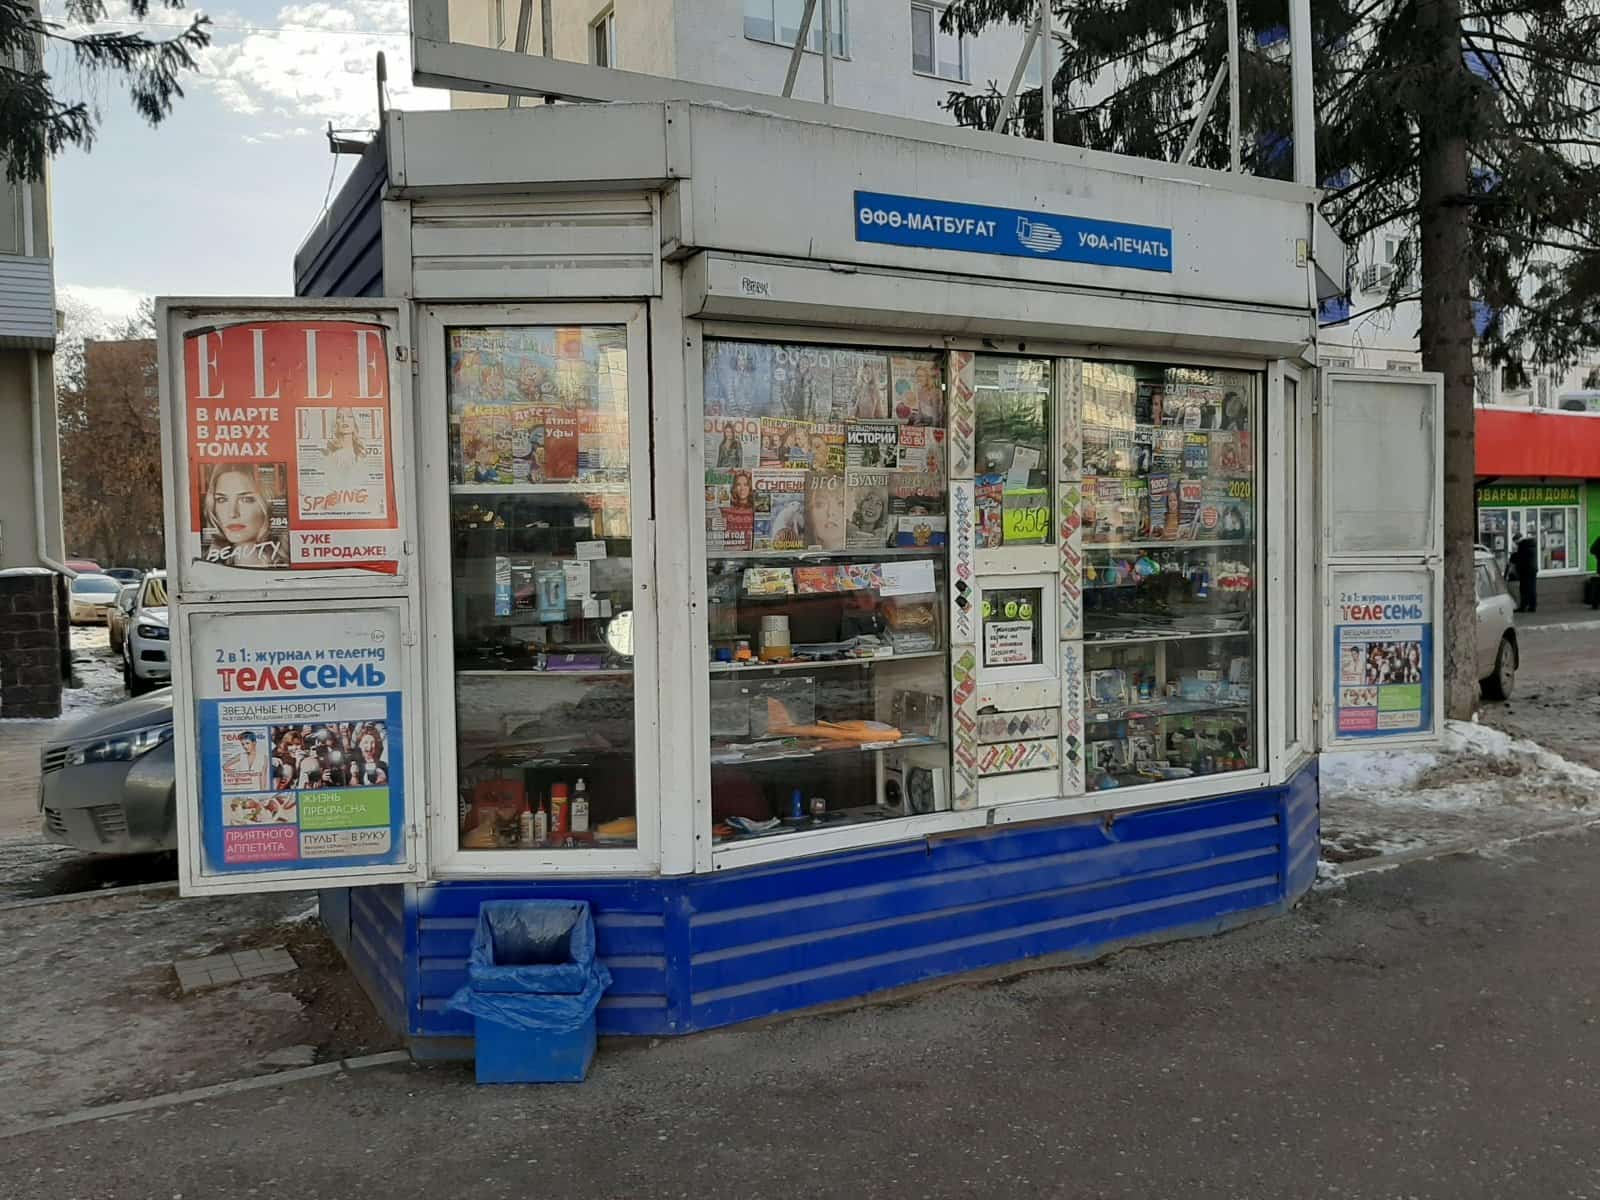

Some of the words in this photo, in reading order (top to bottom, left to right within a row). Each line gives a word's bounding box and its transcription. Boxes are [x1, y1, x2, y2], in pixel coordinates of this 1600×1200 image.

[1078, 231, 1169, 257] УФА-ПЕЧАТЬ
[195, 328, 385, 399] ELLE
[196, 407, 208, 422] В
[215, 407, 279, 422] МАРТЕ
[196, 424, 208, 440] В
[215, 424, 270, 440] ДВУХ
[545, 427, 574, 439] Уфы
[847, 432, 896, 444] ИСТОРИИ
[196, 442, 269, 457] ТОМАХ
[1229, 480, 1250, 498] 2020
[1477, 489, 1518, 501] ОВАРЫ
[1520, 489, 1544, 502] ДЛЯ
[1546, 488, 1576, 501] ДОМА
[300, 534, 331, 545] УЖЕ
[206, 541, 281, 562] BEAUTY
[301, 547, 310, 558] В
[313, 546, 386, 558] ПРОДАЖЕ!
[1341, 592, 1346, 601] 2
[216, 649, 225, 663] 2
[229, 652, 236, 663] в
[240, 648, 251, 662] 1:
[256, 650, 312, 665] журнал
[315, 651, 325, 660] и
[223, 704, 277, 716] ЗВЕЗДНЫЕ
[280, 702, 337, 714] НОВОСТИ
[303, 791, 342, 803] ЖИЗНЬ
[303, 804, 367, 817] ПРЕКРАСНА
[225, 828, 294, 842] ПРИЯТНОГО
[303, 833, 339, 845] ПУЛЬТ
[351, 831, 358, 842] В
[359, 830, 387, 842] РУКУ
[226, 842, 285, 854] АППЕТИТА
